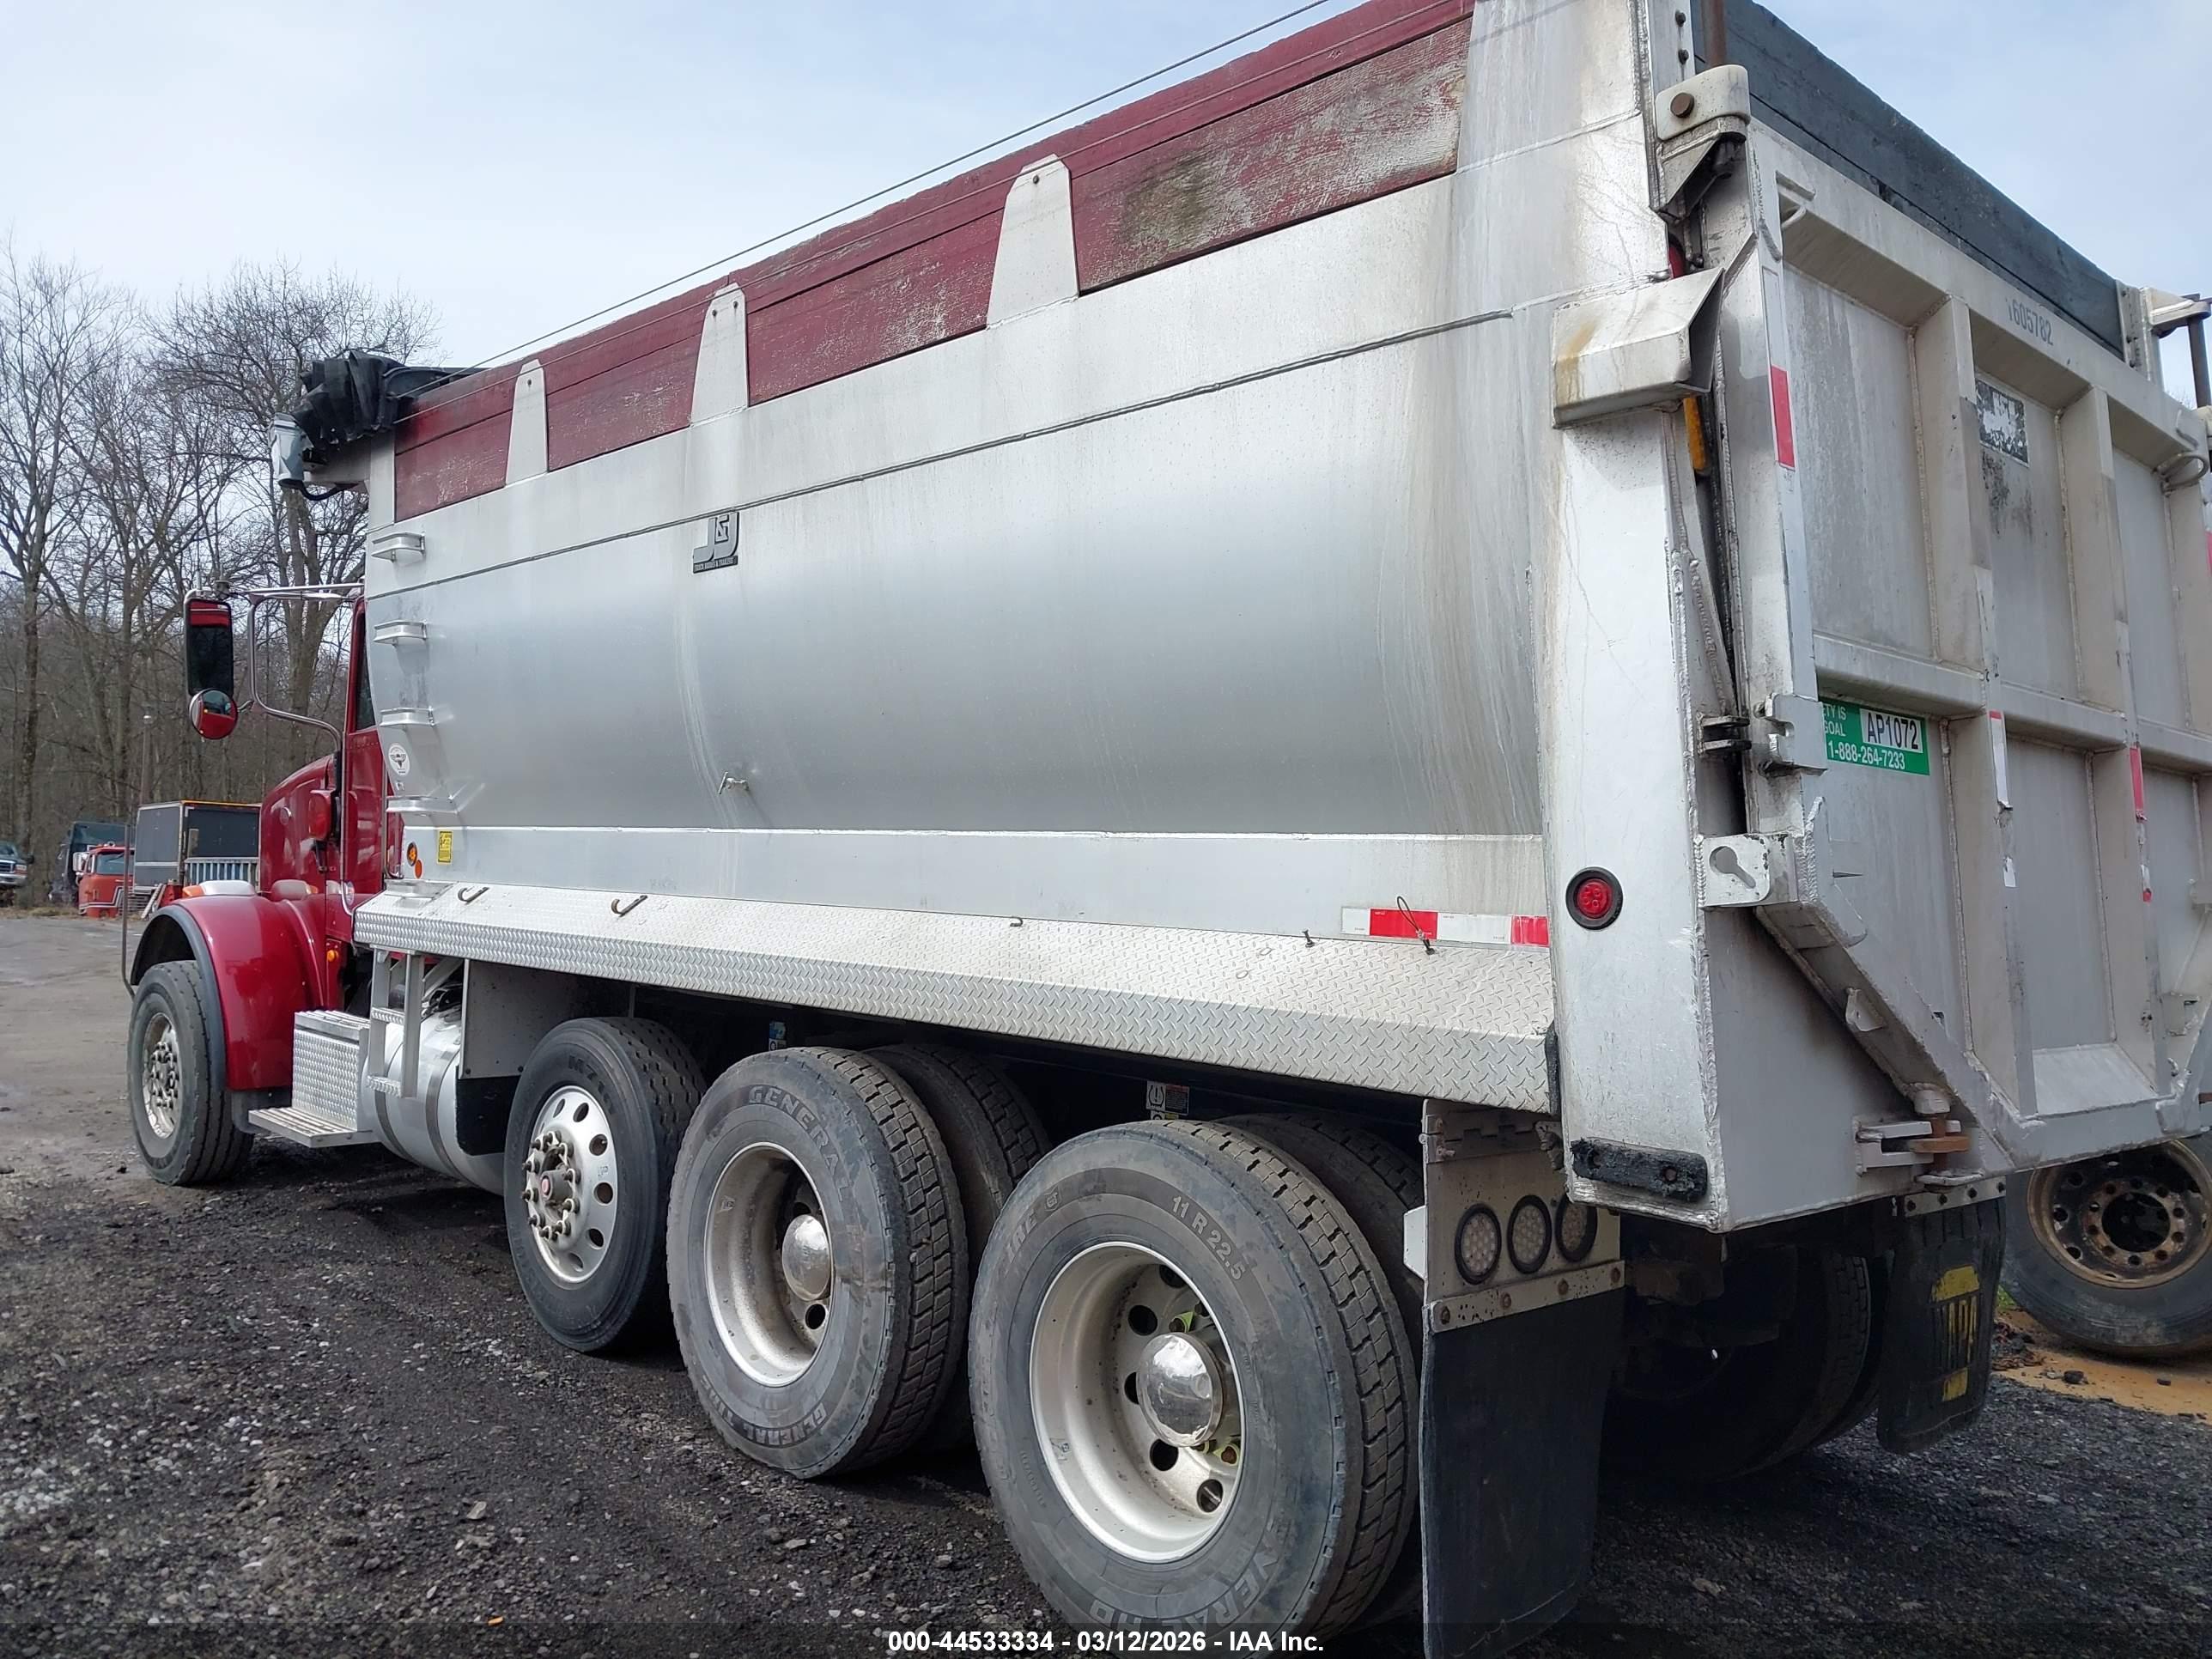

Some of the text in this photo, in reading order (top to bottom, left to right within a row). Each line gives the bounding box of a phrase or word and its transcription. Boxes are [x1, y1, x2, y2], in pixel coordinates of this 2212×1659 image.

[1838, 705, 1847, 721] IS
[1867, 712, 1918, 750] AP1072
[1828, 741, 1905, 769] 1-888-264-7233
[749, 1085, 850, 1202] GENERAL
[1172, 1196, 1246, 1280] 11 R 22.5
[743, 1402, 827, 1445] GENERAL
